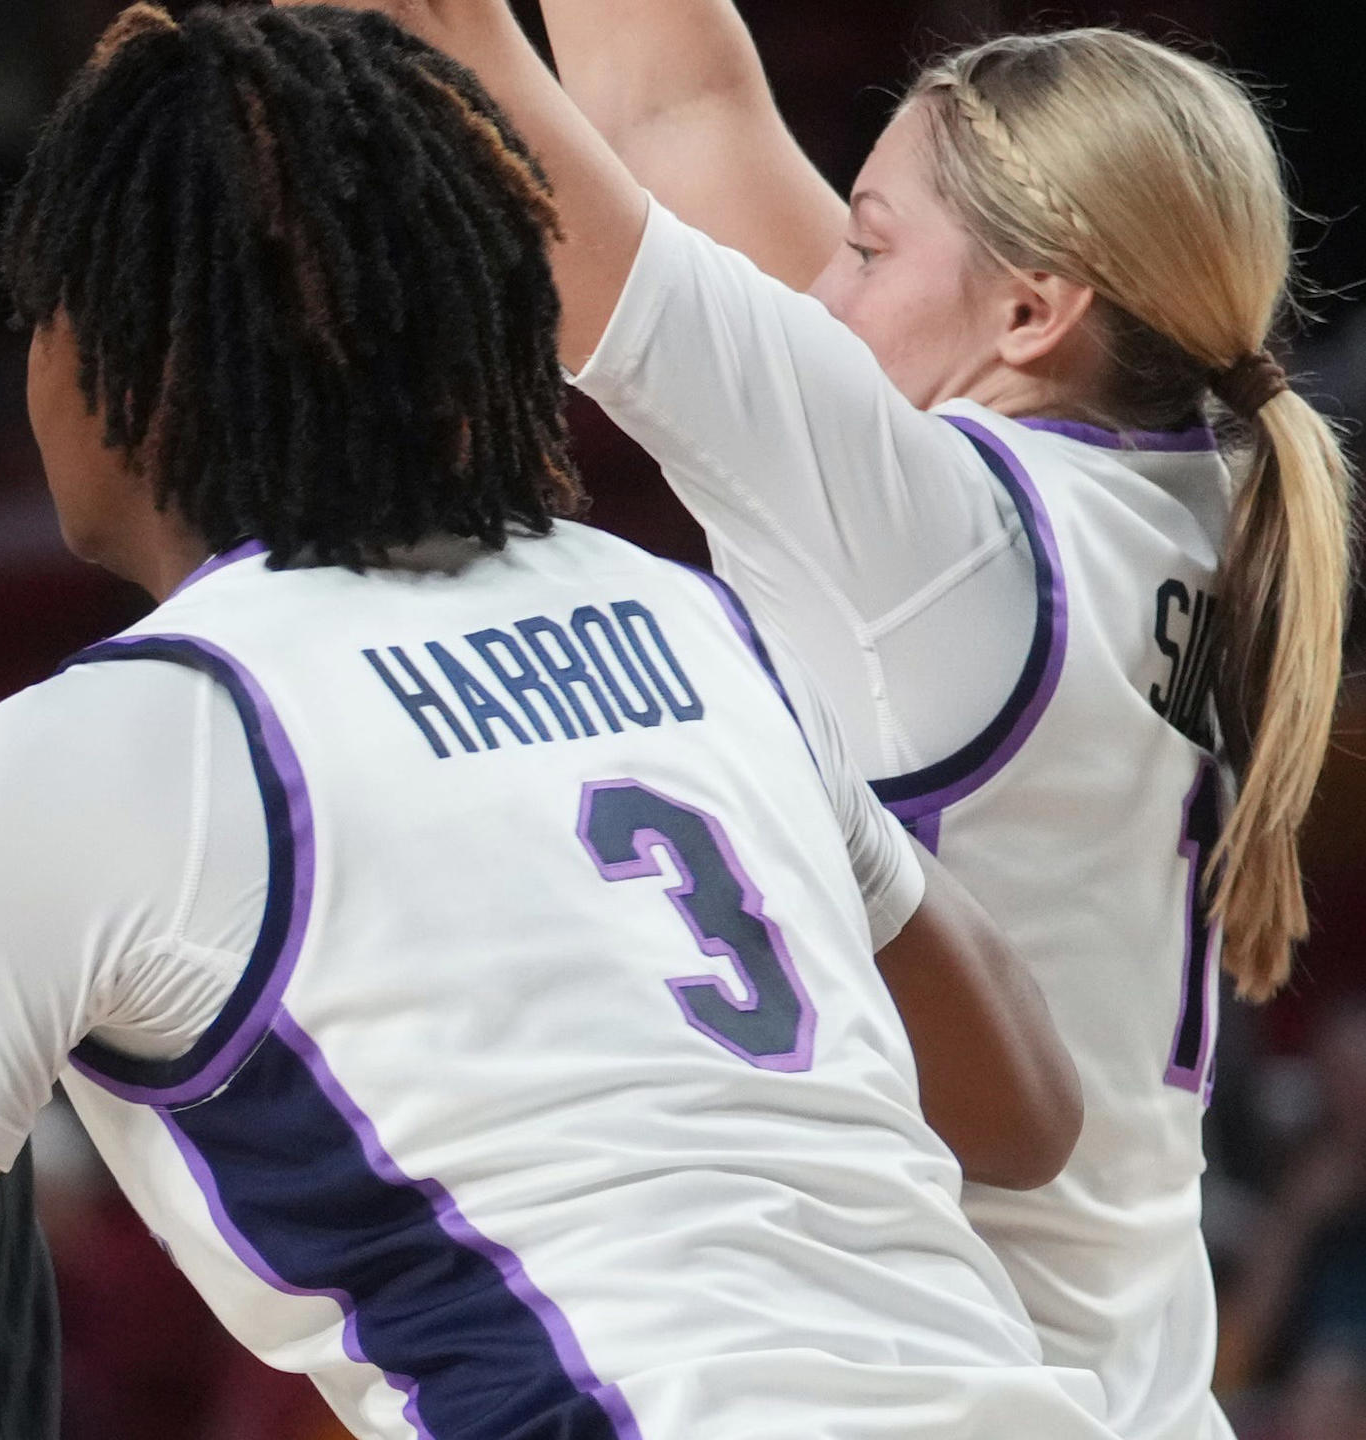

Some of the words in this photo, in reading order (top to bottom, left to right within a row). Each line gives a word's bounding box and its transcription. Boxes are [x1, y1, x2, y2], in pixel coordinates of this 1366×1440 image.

[360, 599, 704, 760] HARROD
[575, 777, 819, 1073] 3
[1162, 754, 1225, 1107] 1
